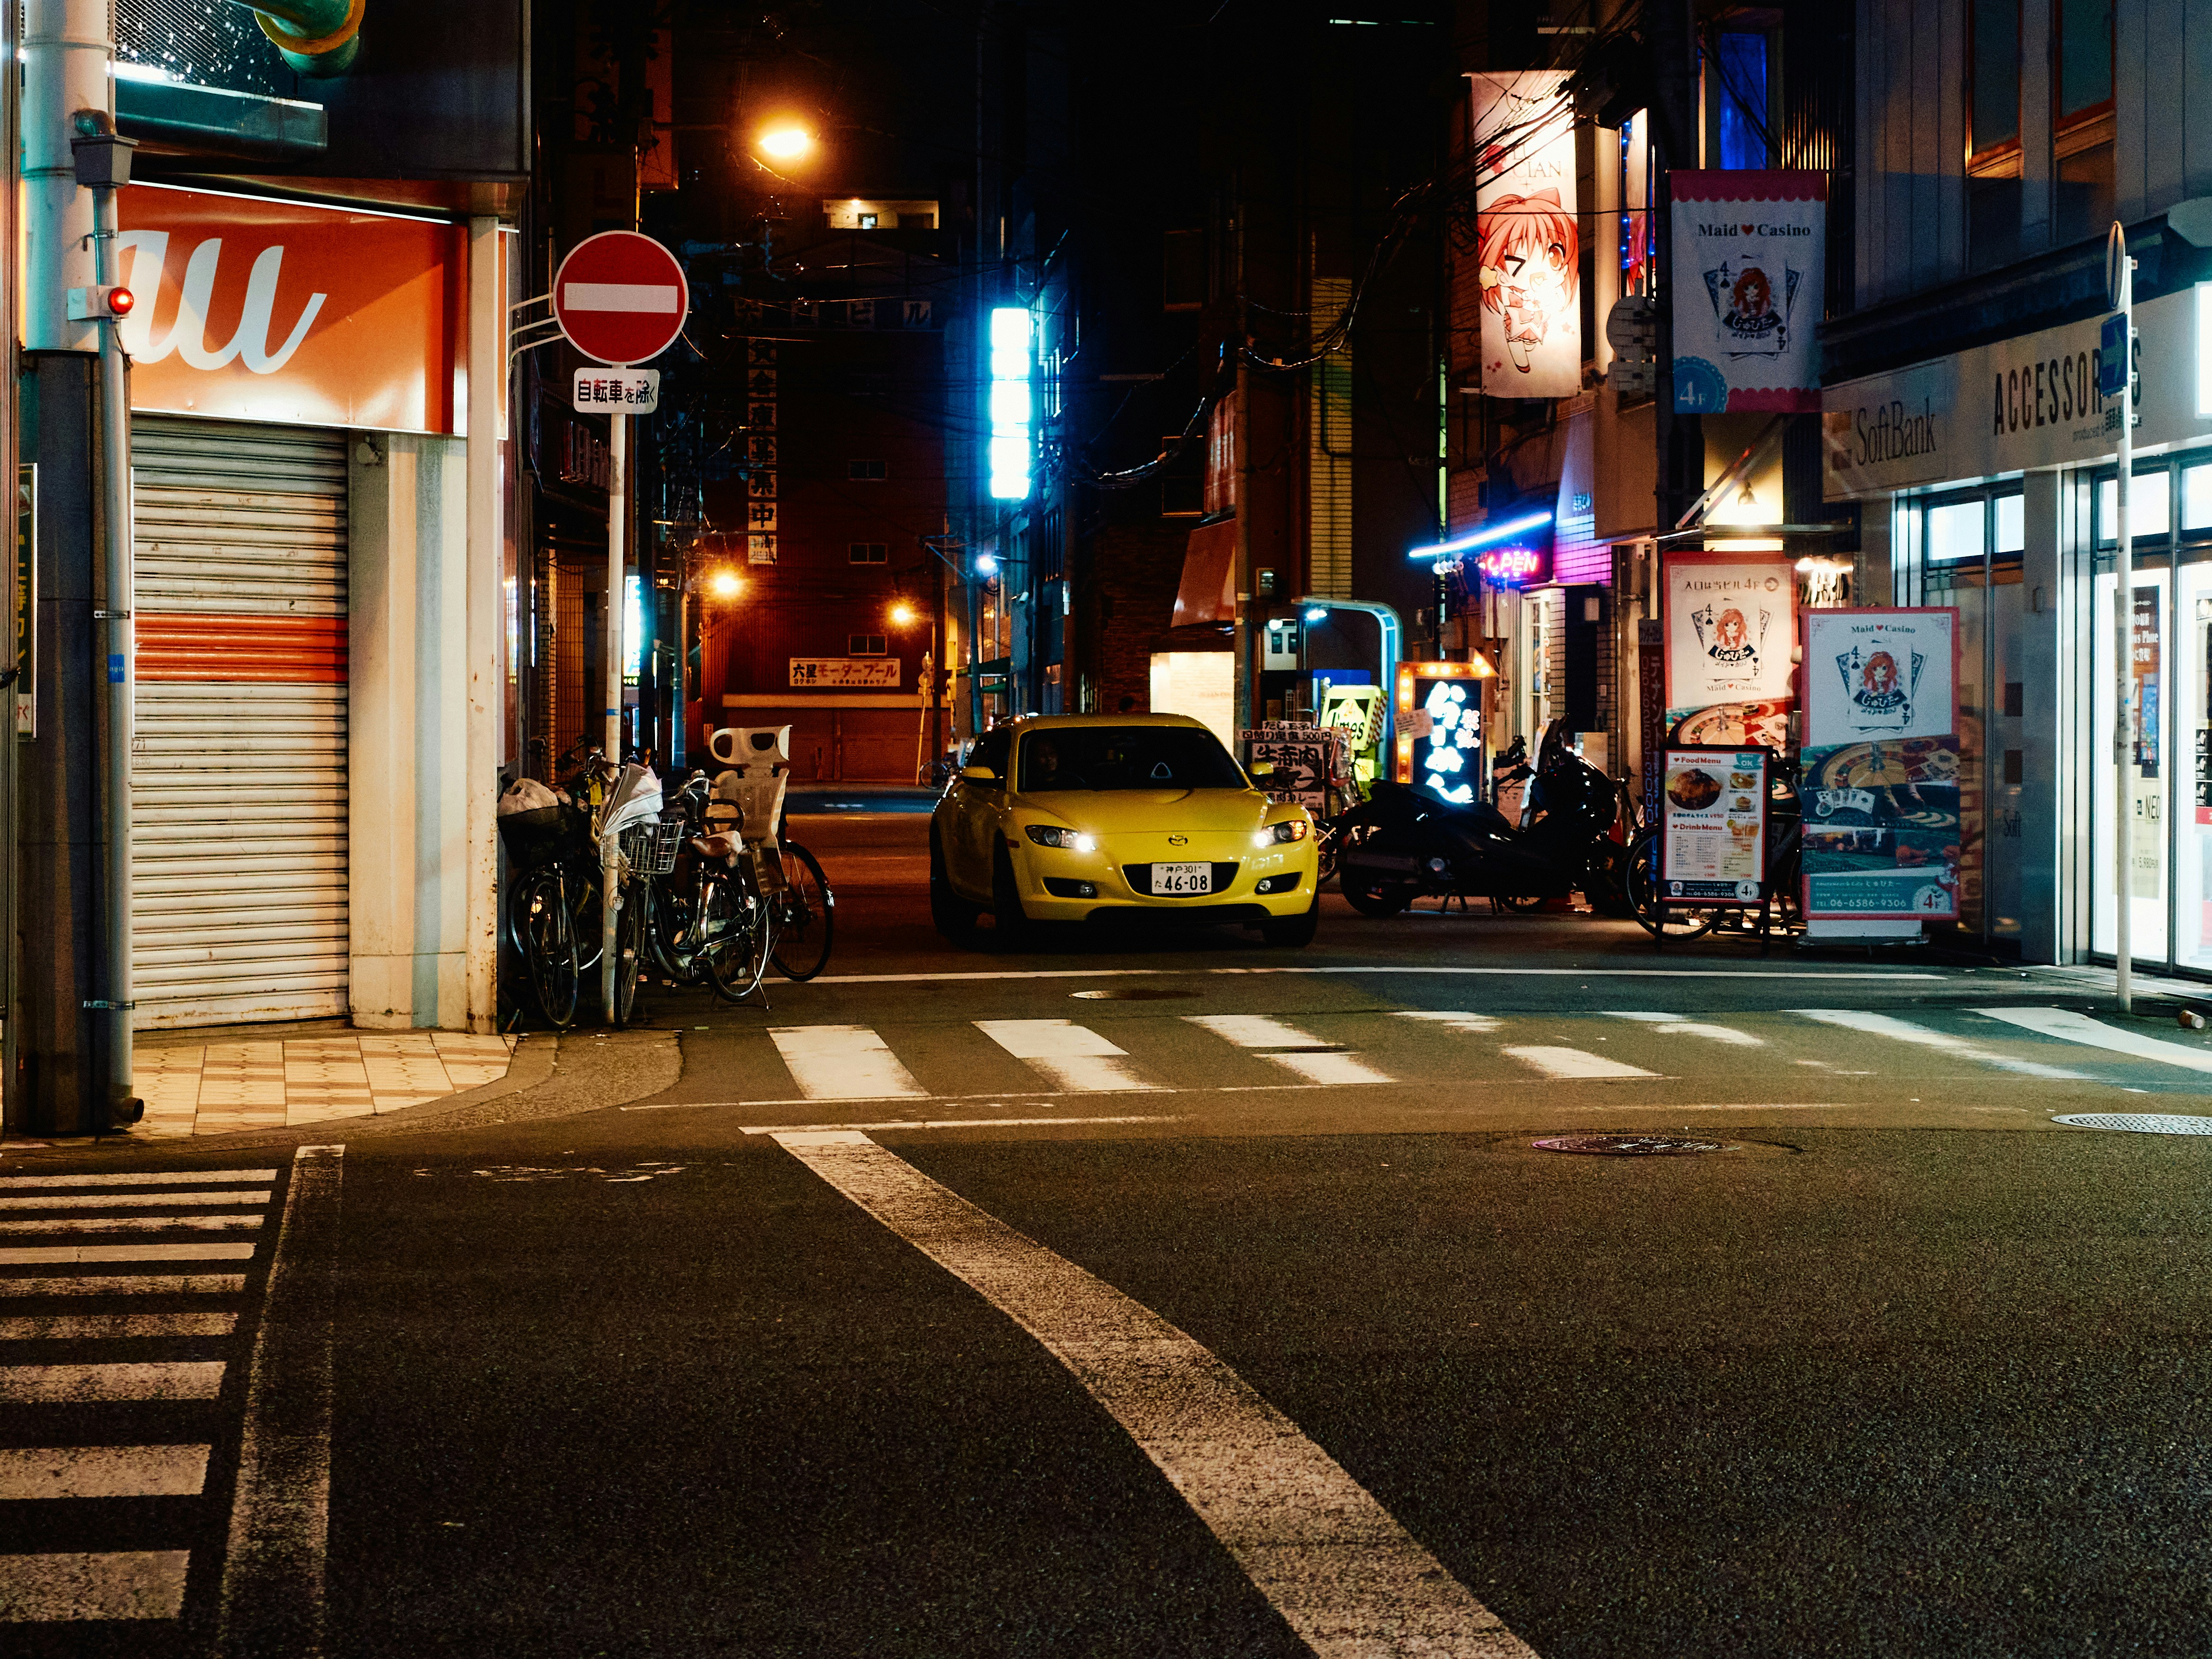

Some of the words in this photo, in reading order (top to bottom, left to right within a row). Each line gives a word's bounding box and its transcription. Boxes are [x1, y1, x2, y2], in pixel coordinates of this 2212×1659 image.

[1513, 161, 1562, 178] CIAN
[1698, 224, 1738, 236] Maid
[1757, 224, 1811, 237] Casino
[118, 229, 327, 374] au
[578, 379, 655, 404] 自転車を除く
[1679, 380, 1707, 406] 4F
[1994, 337, 2142, 435] ACCESSORS
[1856, 396, 1937, 466] SoftBank
[1487, 555, 1538, 573] OPEN
[1851, 625, 1874, 634] Maid
[1885, 625, 1916, 634] Casino
[793, 663, 897, 678] 六星モータープール
[1650, 656, 1663, 749] テナント
[1302, 731, 1332, 741] 500円
[1155, 880, 1162, 888] た
[1164, 875, 1208, 891] 46-08
[1830, 899, 1907, 907] 06-6586-9306
